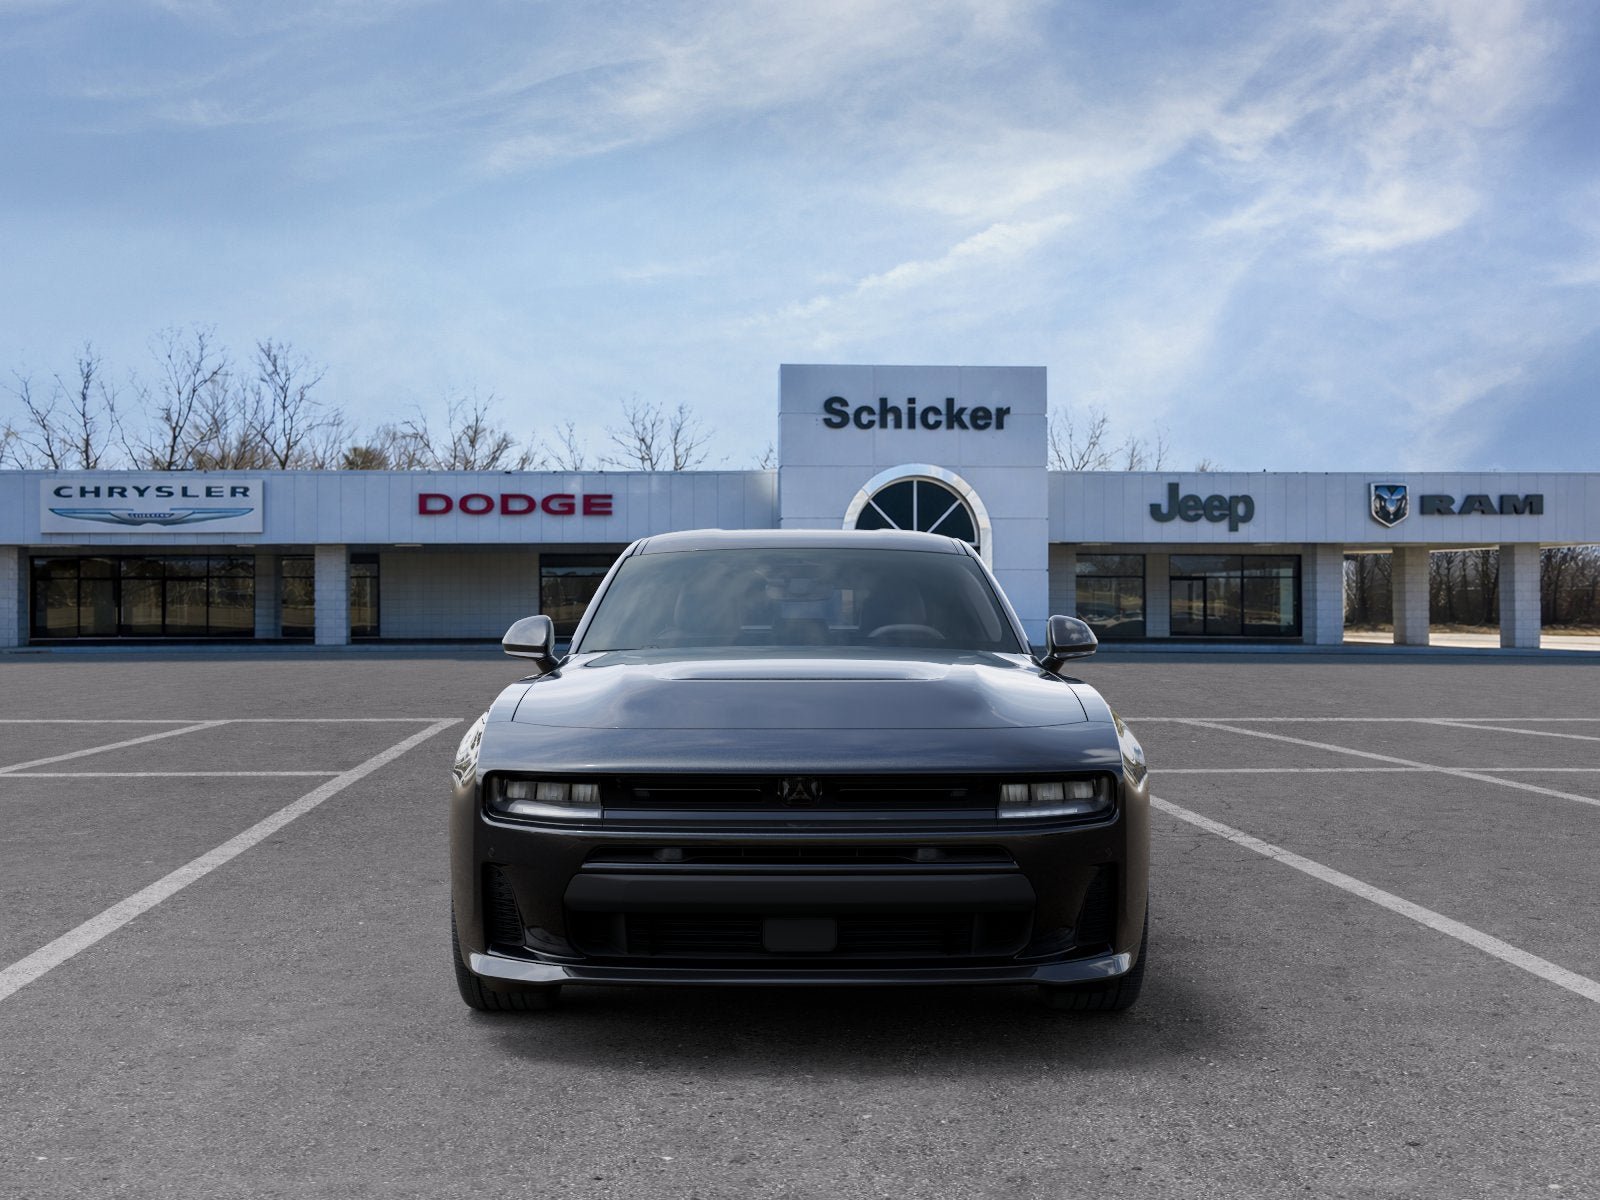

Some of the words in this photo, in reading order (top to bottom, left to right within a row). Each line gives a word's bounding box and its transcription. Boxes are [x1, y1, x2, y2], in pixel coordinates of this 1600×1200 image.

[823, 396, 1010, 430] Schicker
[53, 485, 250, 499] CHRYSLER
[418, 493, 613, 516] DODGE
[1149, 482, 1254, 532] Jeep
[1420, 494, 1544, 516] RAM
